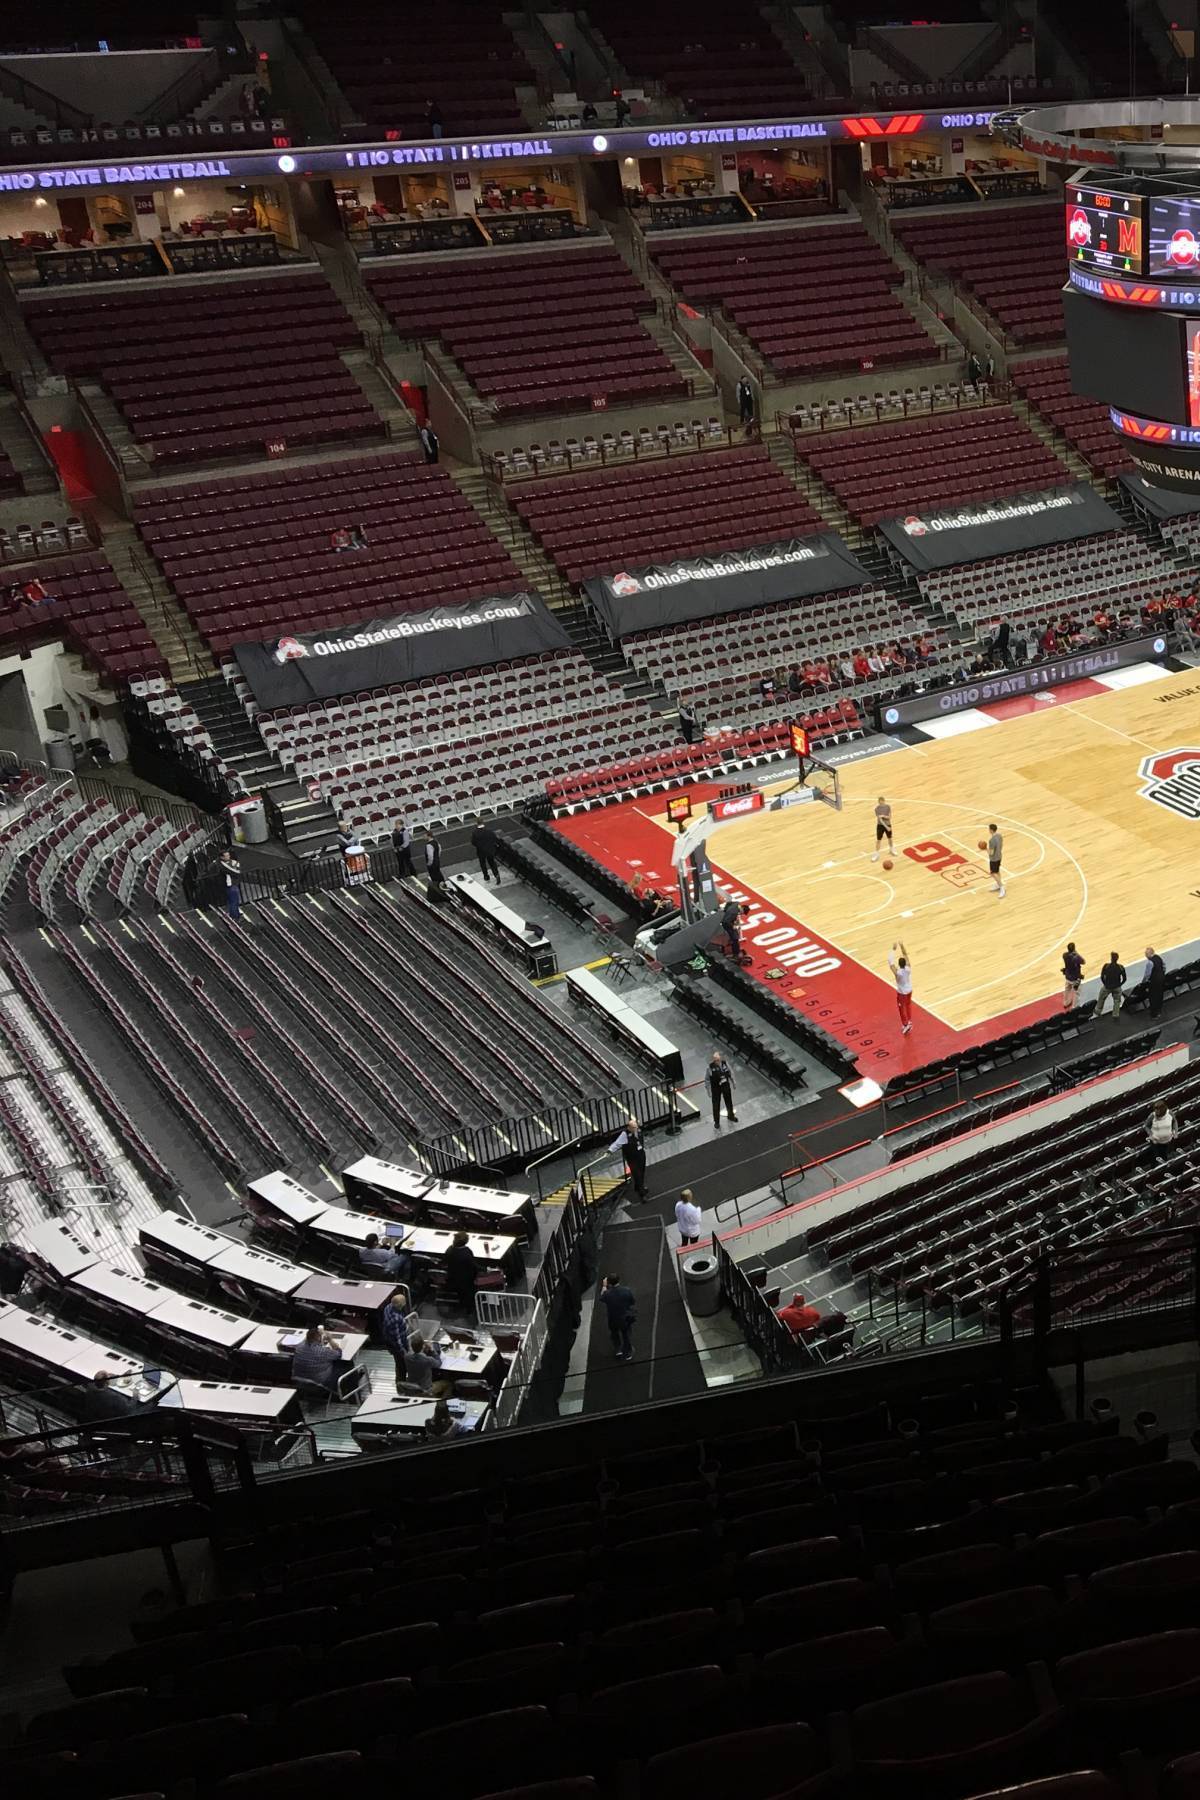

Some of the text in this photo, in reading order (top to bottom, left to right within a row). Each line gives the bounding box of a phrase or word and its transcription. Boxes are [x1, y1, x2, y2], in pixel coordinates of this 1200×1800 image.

[942, 114, 974, 128] OHIO
[648, 123, 826, 147] OHIO STATE BASKETBALL
[38, 168, 102, 188] STATE
[104, 161, 230, 185] BASKETBALL
[593, 399, 606, 407] 105
[269, 444, 285, 454] 104
[1165, 466, 1200, 481] ARENA
[931, 494, 1072, 533] OhioStateBuckeyes.com
[644, 545, 815, 590] OhioStateBuckeyes.com
[313, 602, 521, 658] OhioStateBuckeyes.com
[940, 688, 979, 710] OHIO
[983, 676, 1026, 699] STATE
[1153, 688, 1200, 702] VALUE
[752, 927, 842, 978] OHIO
[806, 999, 819, 1007] 5
[873, 1048, 890, 1058] 10
